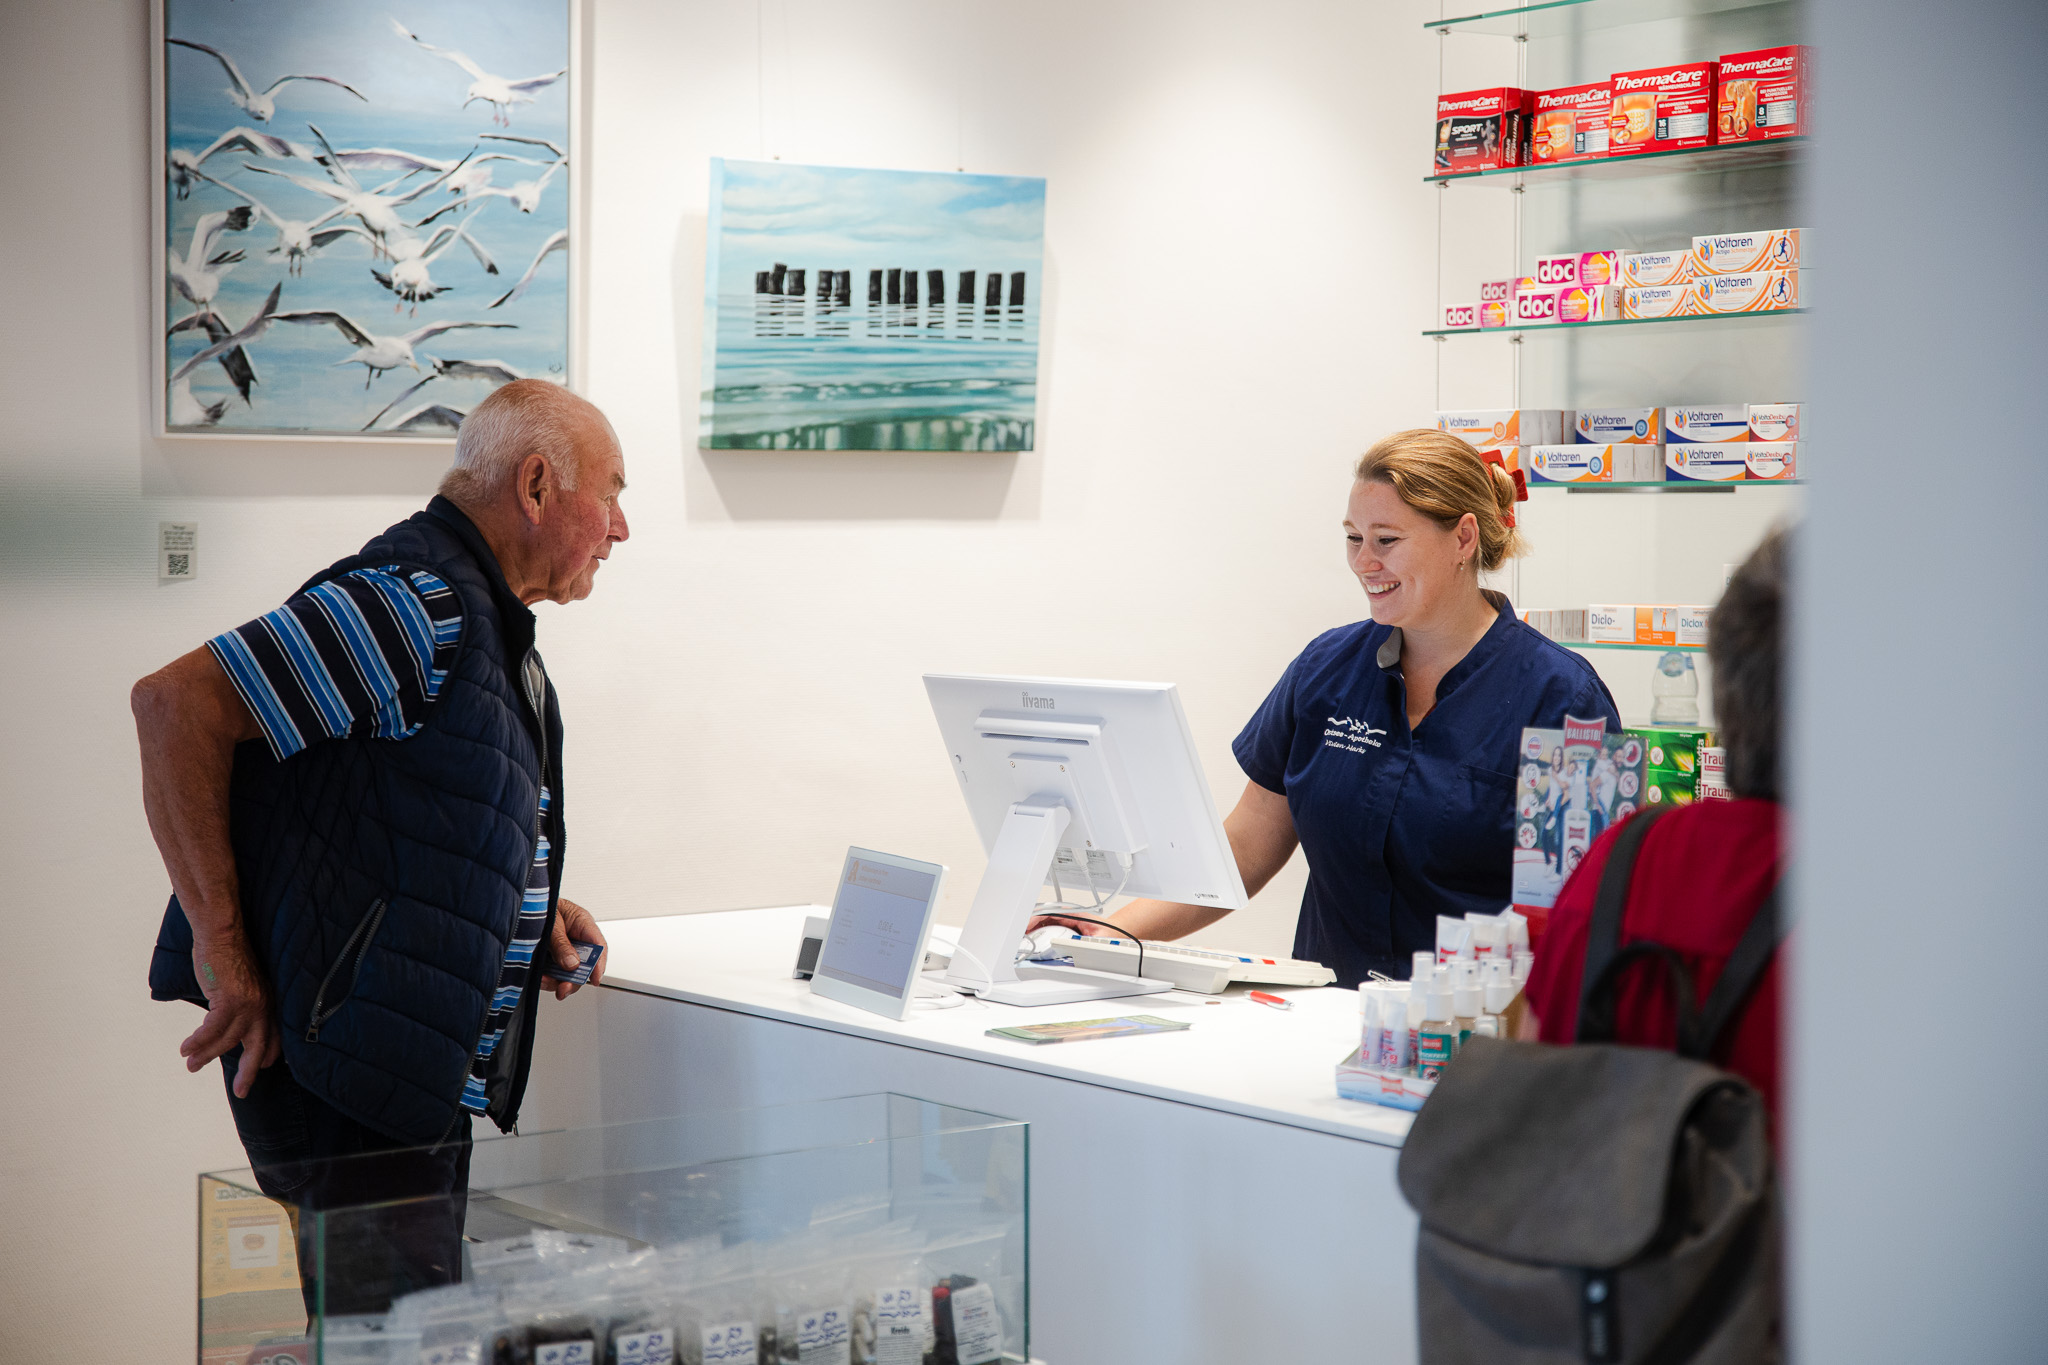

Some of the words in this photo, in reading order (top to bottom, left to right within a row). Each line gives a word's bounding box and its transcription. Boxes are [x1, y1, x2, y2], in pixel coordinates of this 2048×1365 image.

[1721, 57, 1794, 74] ThermaCare
[1615, 70, 1703, 90] ThermaCare
[1438, 96, 1500, 112] ThermaCare
[1451, 123, 1483, 135] SPORT
[1714, 237, 1752, 249] Voltaren
[1640, 256, 1671, 265] Voltaren
[1539, 259, 1574, 283] doc
[1714, 277, 1752, 288] Voltaren
[1482, 283, 1507, 300] doc
[1640, 289, 1671, 299] Voltaren
[1519, 294, 1555, 318] doc
[1446, 307, 1473, 325] doc
[1449, 417, 1479, 427] Voltaren
[1592, 415, 1626, 425] Voltaren
[1688, 411, 1723, 421] Voltaren
[1547, 452, 1581, 462] Voltaren
[1688, 449, 1724, 460] Voltaren
[1591, 614, 1615, 625] Diclo-
[1681, 618, 1704, 628] Diclox
[1022, 691, 1055, 709] iiyama
[1567, 728, 1601, 741] BALLISTOL
[1703, 752, 1725, 765] Trau
[1702, 784, 1731, 797] Traum
